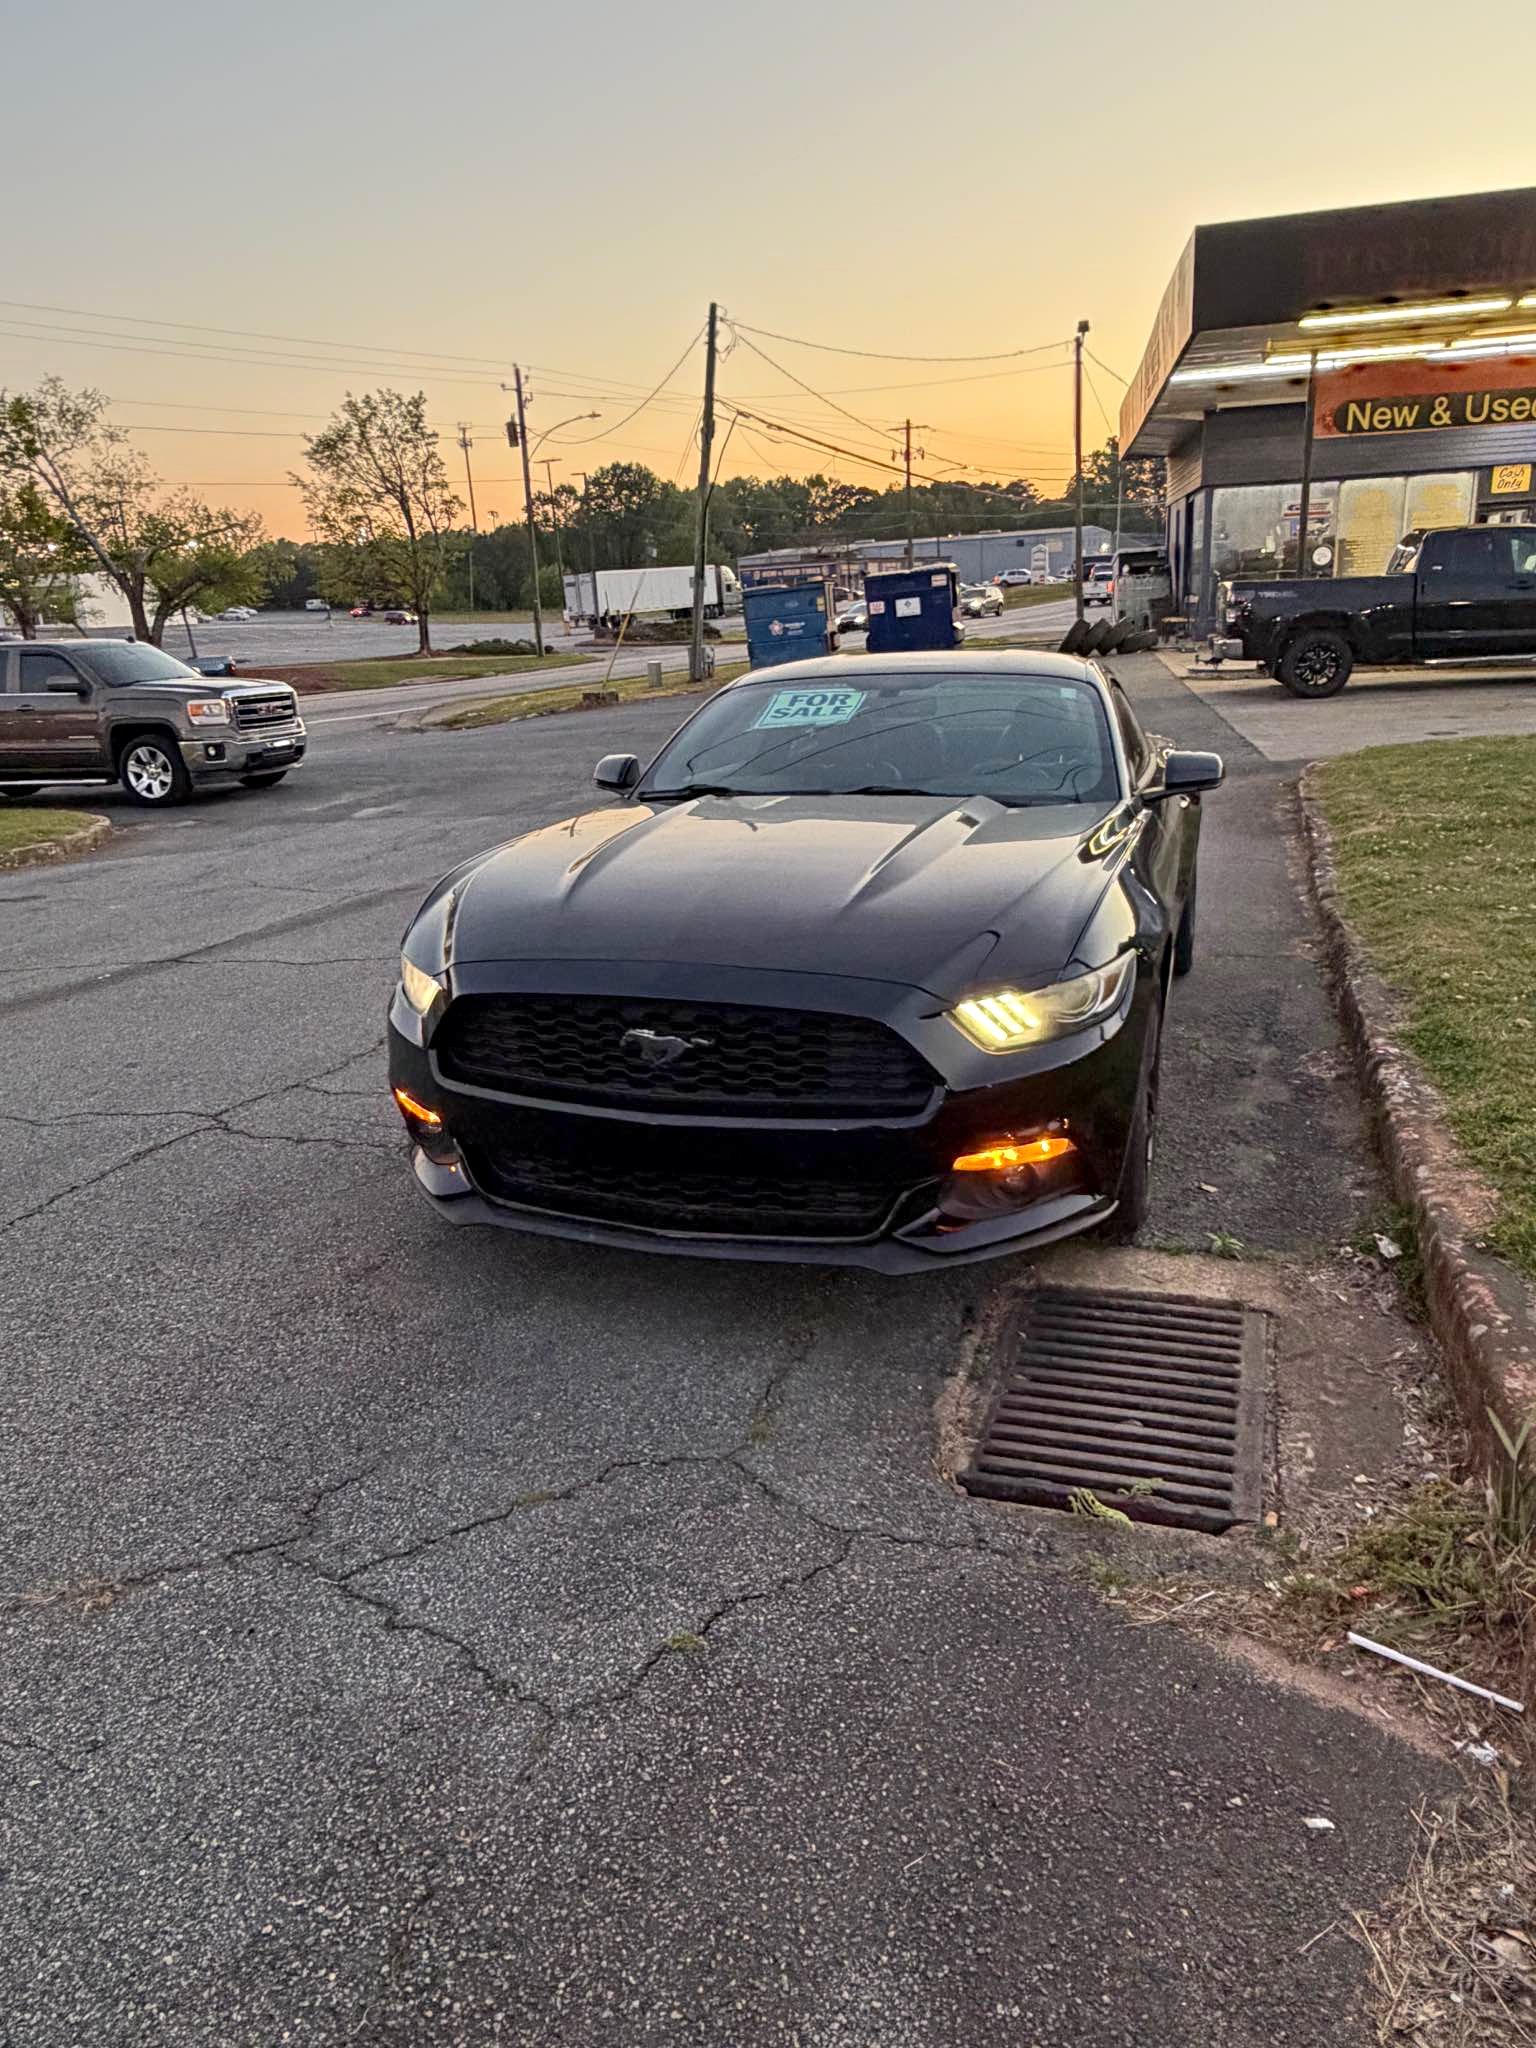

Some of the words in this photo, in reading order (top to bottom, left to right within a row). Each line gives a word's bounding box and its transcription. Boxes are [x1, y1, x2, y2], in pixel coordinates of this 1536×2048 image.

[1346, 401, 1419, 431] New
[1430, 396, 1452, 426] &
[1465, 394, 1536, 423] Use
[1497, 479, 1523, 491] Only
[788, 694, 851, 706] FOR
[770, 705, 853, 719] SALE
